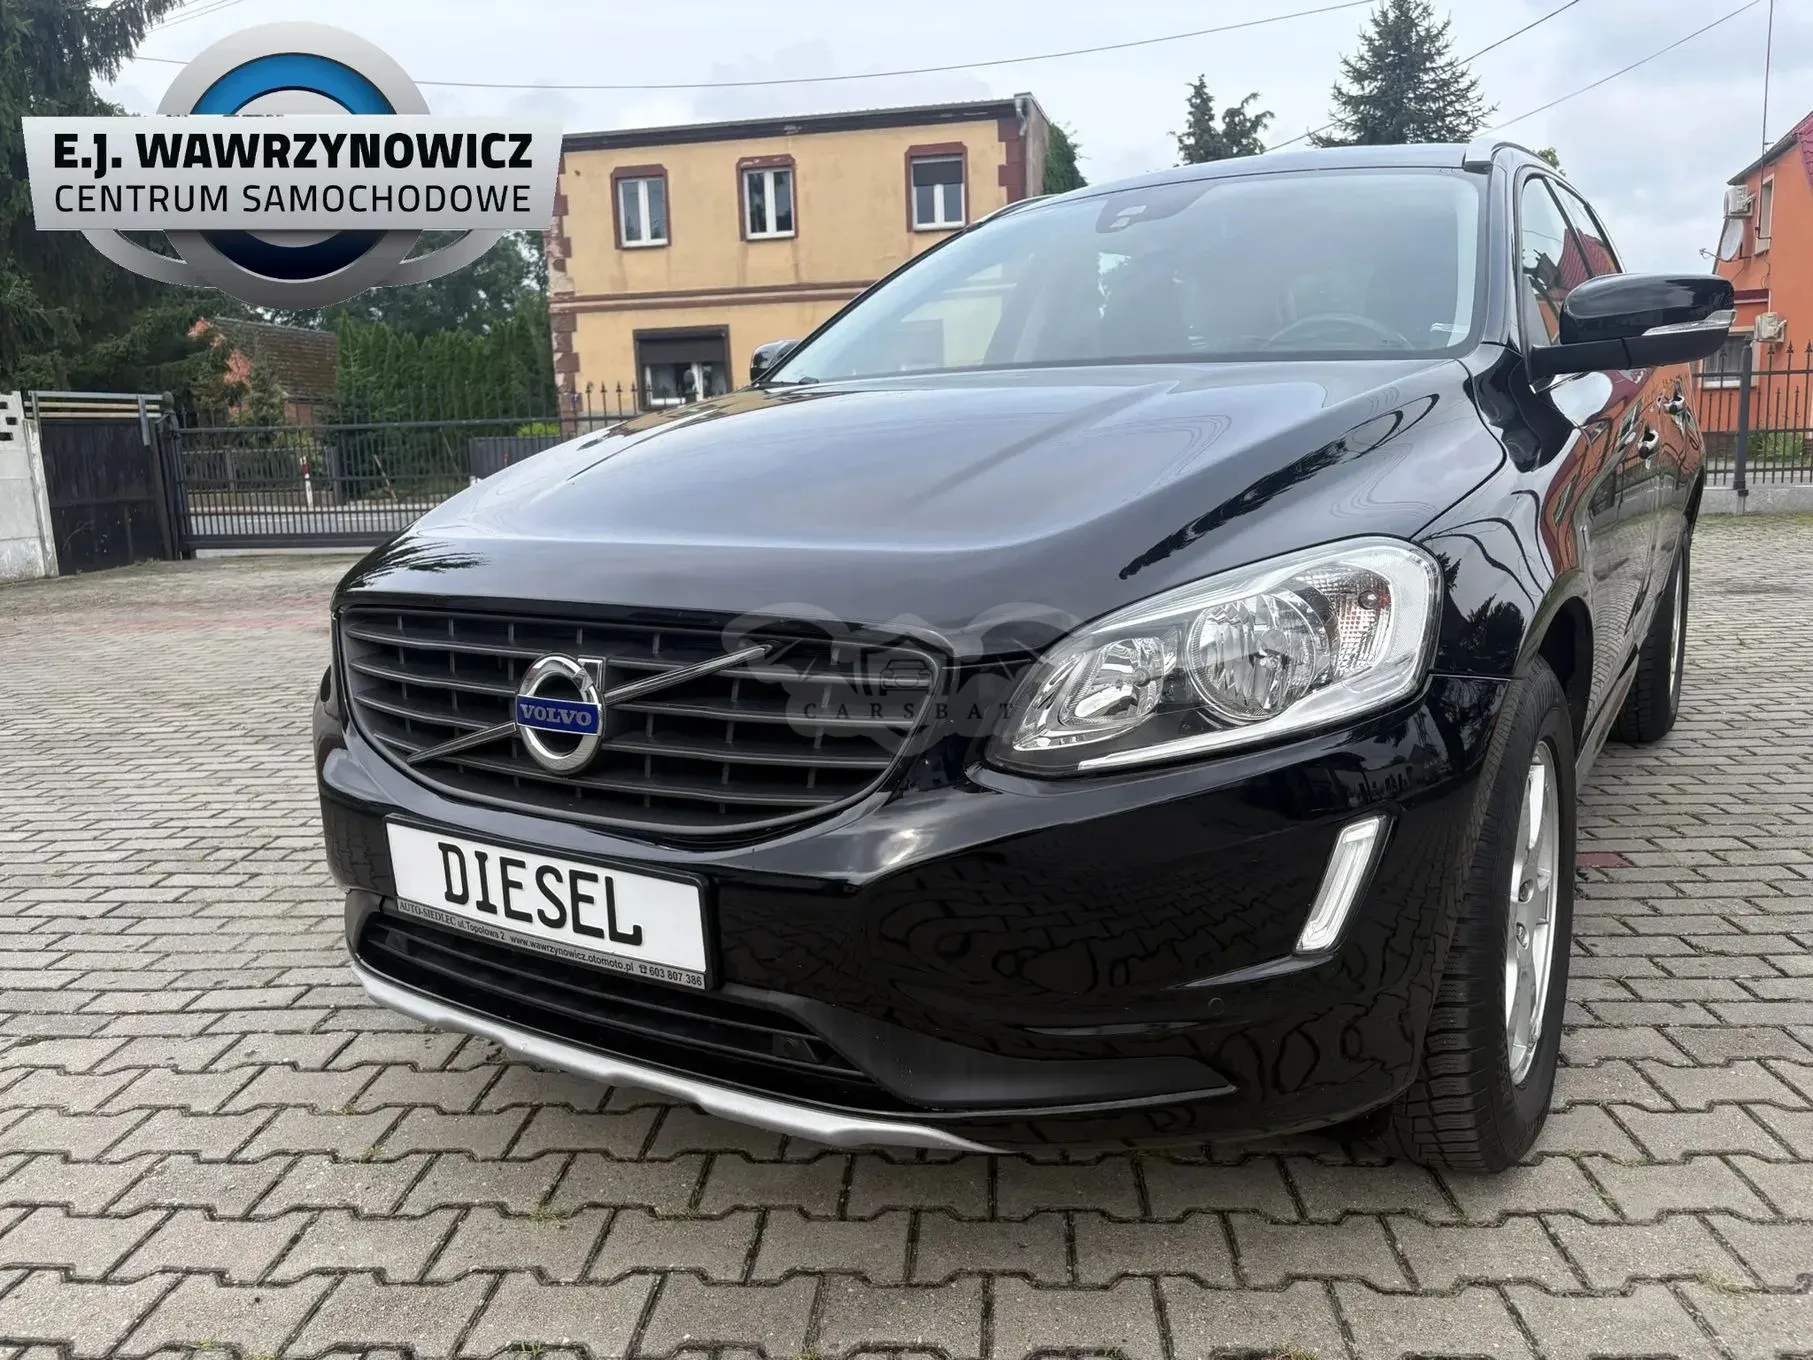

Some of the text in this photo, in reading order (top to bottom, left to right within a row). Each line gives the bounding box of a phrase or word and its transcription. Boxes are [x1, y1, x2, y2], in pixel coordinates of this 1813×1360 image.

[520, 703, 592, 727] VOLVO
[438, 841, 643, 946] DIESEL
[399, 901, 456, 926] AUTO-SIEDLEC
[510, 935, 634, 972] www.wawrzynowicz.otomoto.pl
[649, 966, 665, 979] 603
[667, 971, 684, 983] 807
[686, 975, 702, 987] 386
